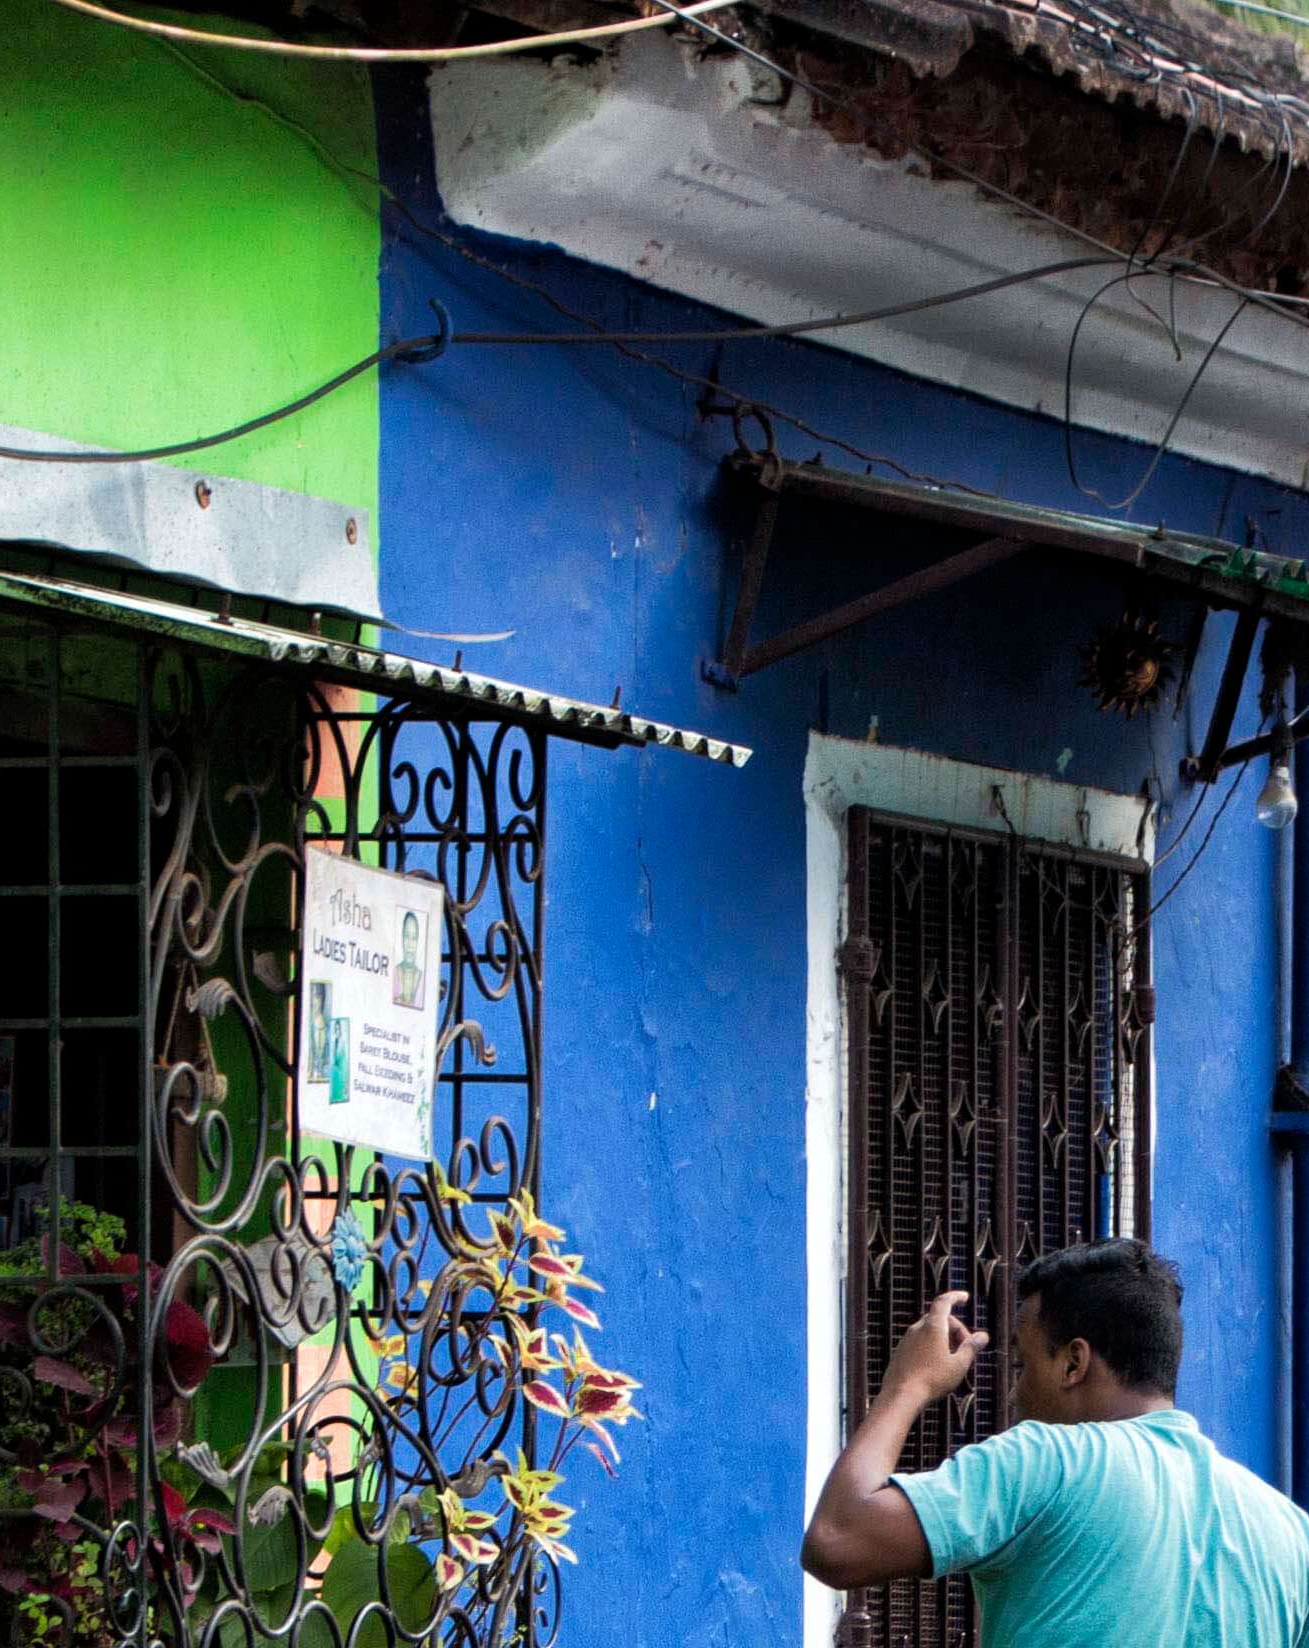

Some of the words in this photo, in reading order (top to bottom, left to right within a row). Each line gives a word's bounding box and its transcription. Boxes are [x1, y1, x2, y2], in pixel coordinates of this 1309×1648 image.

[330, 888, 372, 931] Asha
[313, 928, 346, 964] LADIES
[348, 942, 389, 976] TAILOR
[363, 1023, 402, 1042] SPECIALIST
[403, 1035, 410, 1045] IN
[354, 1079, 381, 1096] SALWAR
[407, 1073, 413, 1084] &
